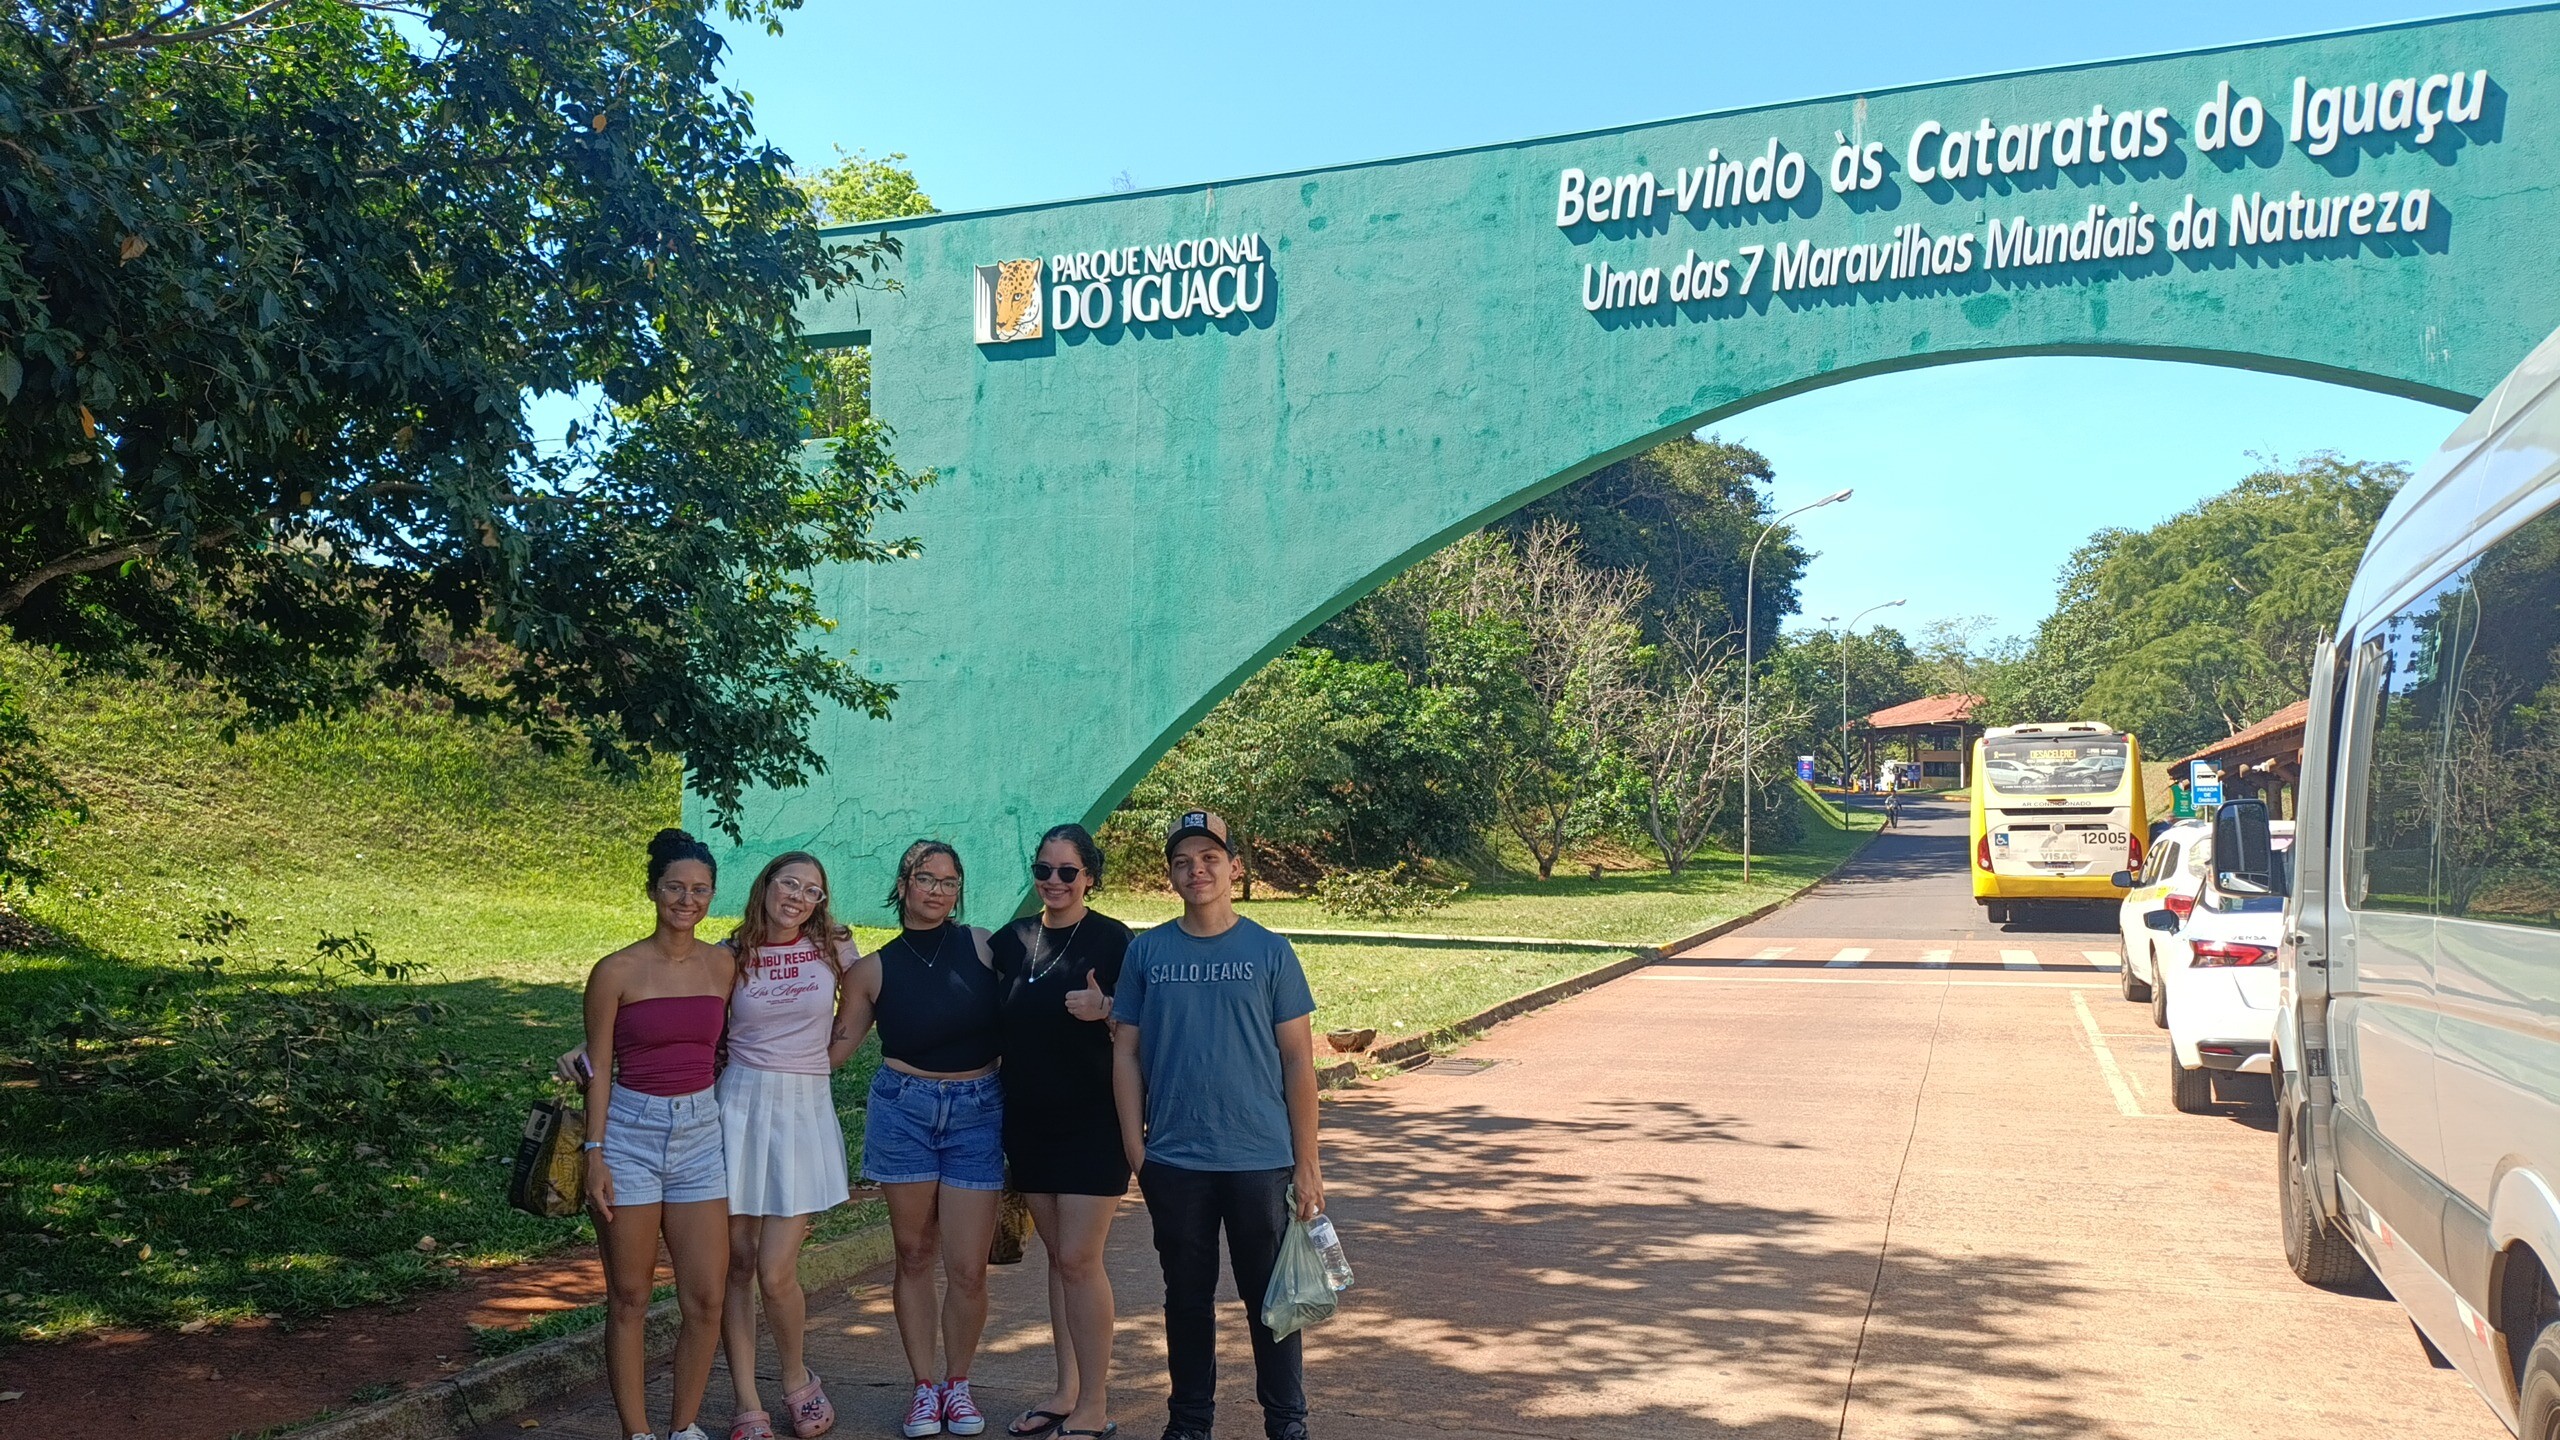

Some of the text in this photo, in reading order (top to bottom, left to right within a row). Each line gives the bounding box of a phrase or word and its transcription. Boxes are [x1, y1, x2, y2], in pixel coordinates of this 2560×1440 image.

[1556, 69, 2488, 228] Bem-vindo às Cataratas do Iguaçu
[1052, 232, 1263, 283] PARQUE NACIONAL
[1583, 187, 2431, 311] Uma das 7 Maravilhas Mundiais da Natureza
[1052, 262, 1264, 330] DO IGUAÇU
[2082, 832, 2127, 844] 12005
[2041, 853, 2078, 861] VISAC
[744, 955, 781, 969] ALIBU
[770, 967, 799, 980] CLUB
[1150, 962, 1253, 985] SALLO JEANS
[746, 982, 819, 999] Los Angeles
